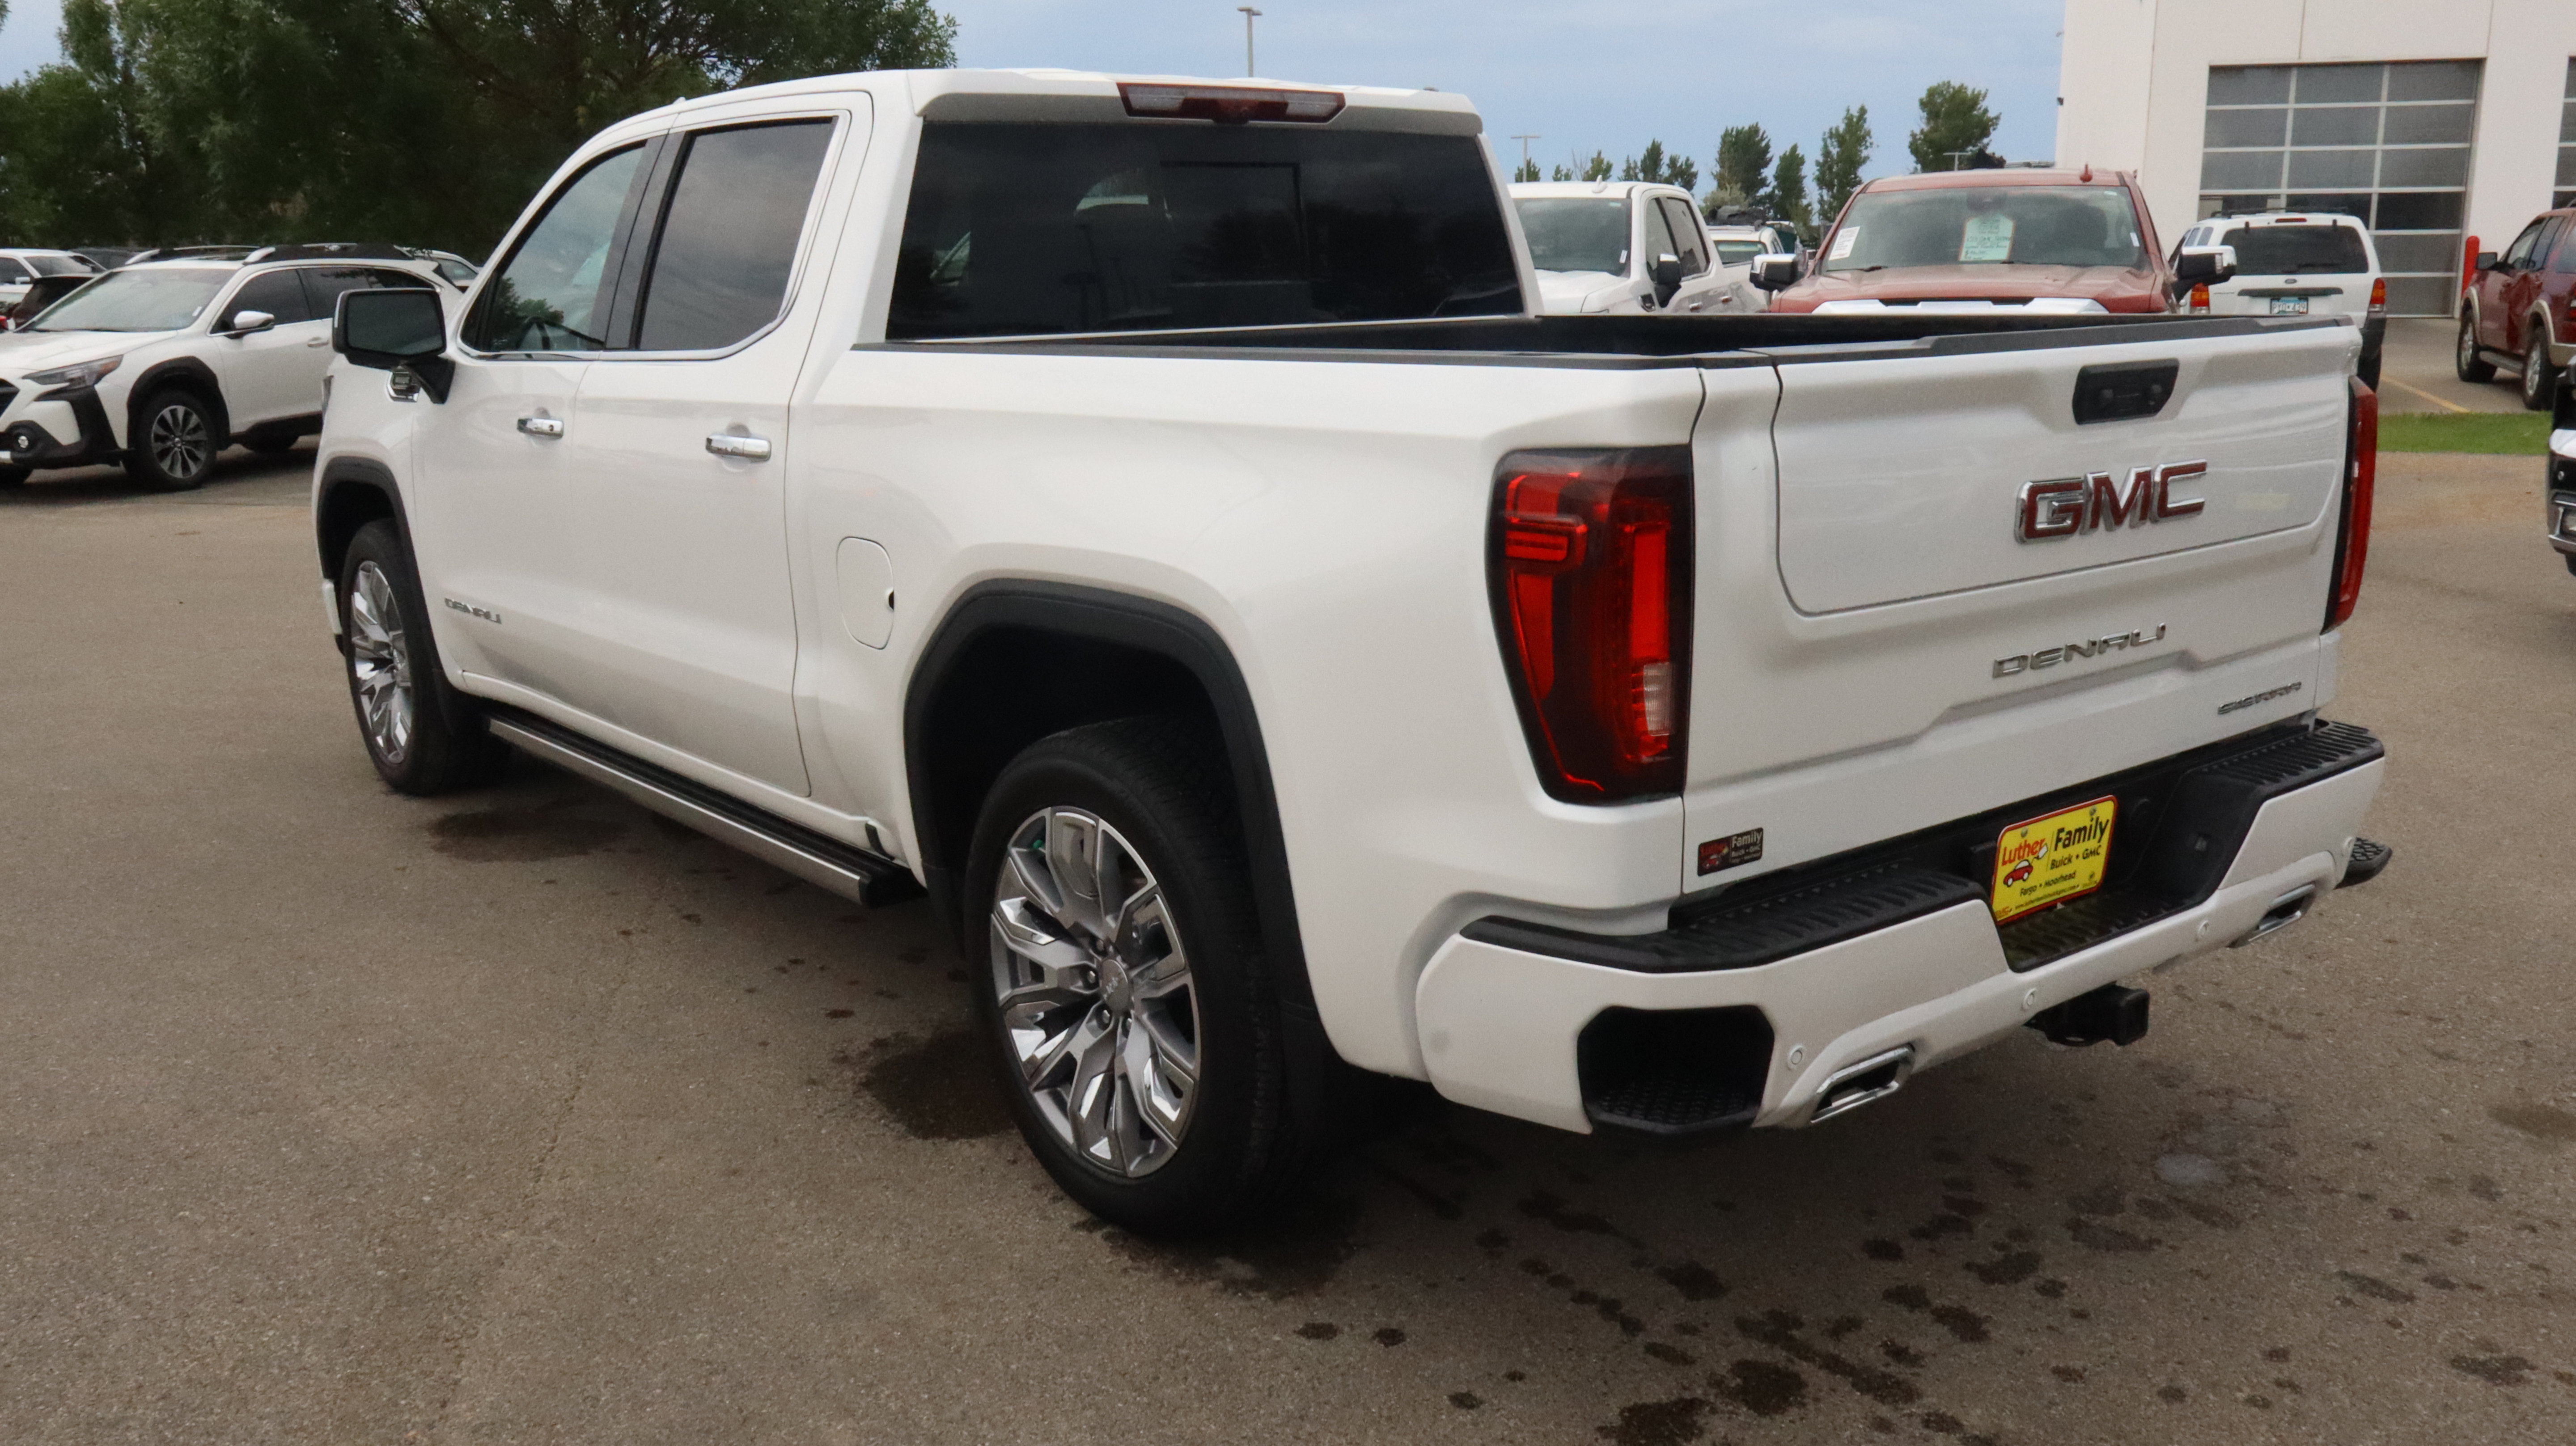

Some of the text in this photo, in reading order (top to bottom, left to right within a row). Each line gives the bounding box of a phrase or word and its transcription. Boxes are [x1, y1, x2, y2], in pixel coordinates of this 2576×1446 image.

[2014, 458, 2207, 543] GMC
[1991, 622, 2166, 679] DENALI
[2217, 681, 2302, 715] SIERRA
[1732, 830, 1763, 848] Family
[2055, 816, 2110, 851] Family
[2002, 839, 2046, 866] Luther
[2051, 845, 2102, 870] Buick GMC
[2020, 885, 2038, 897] Fargo
